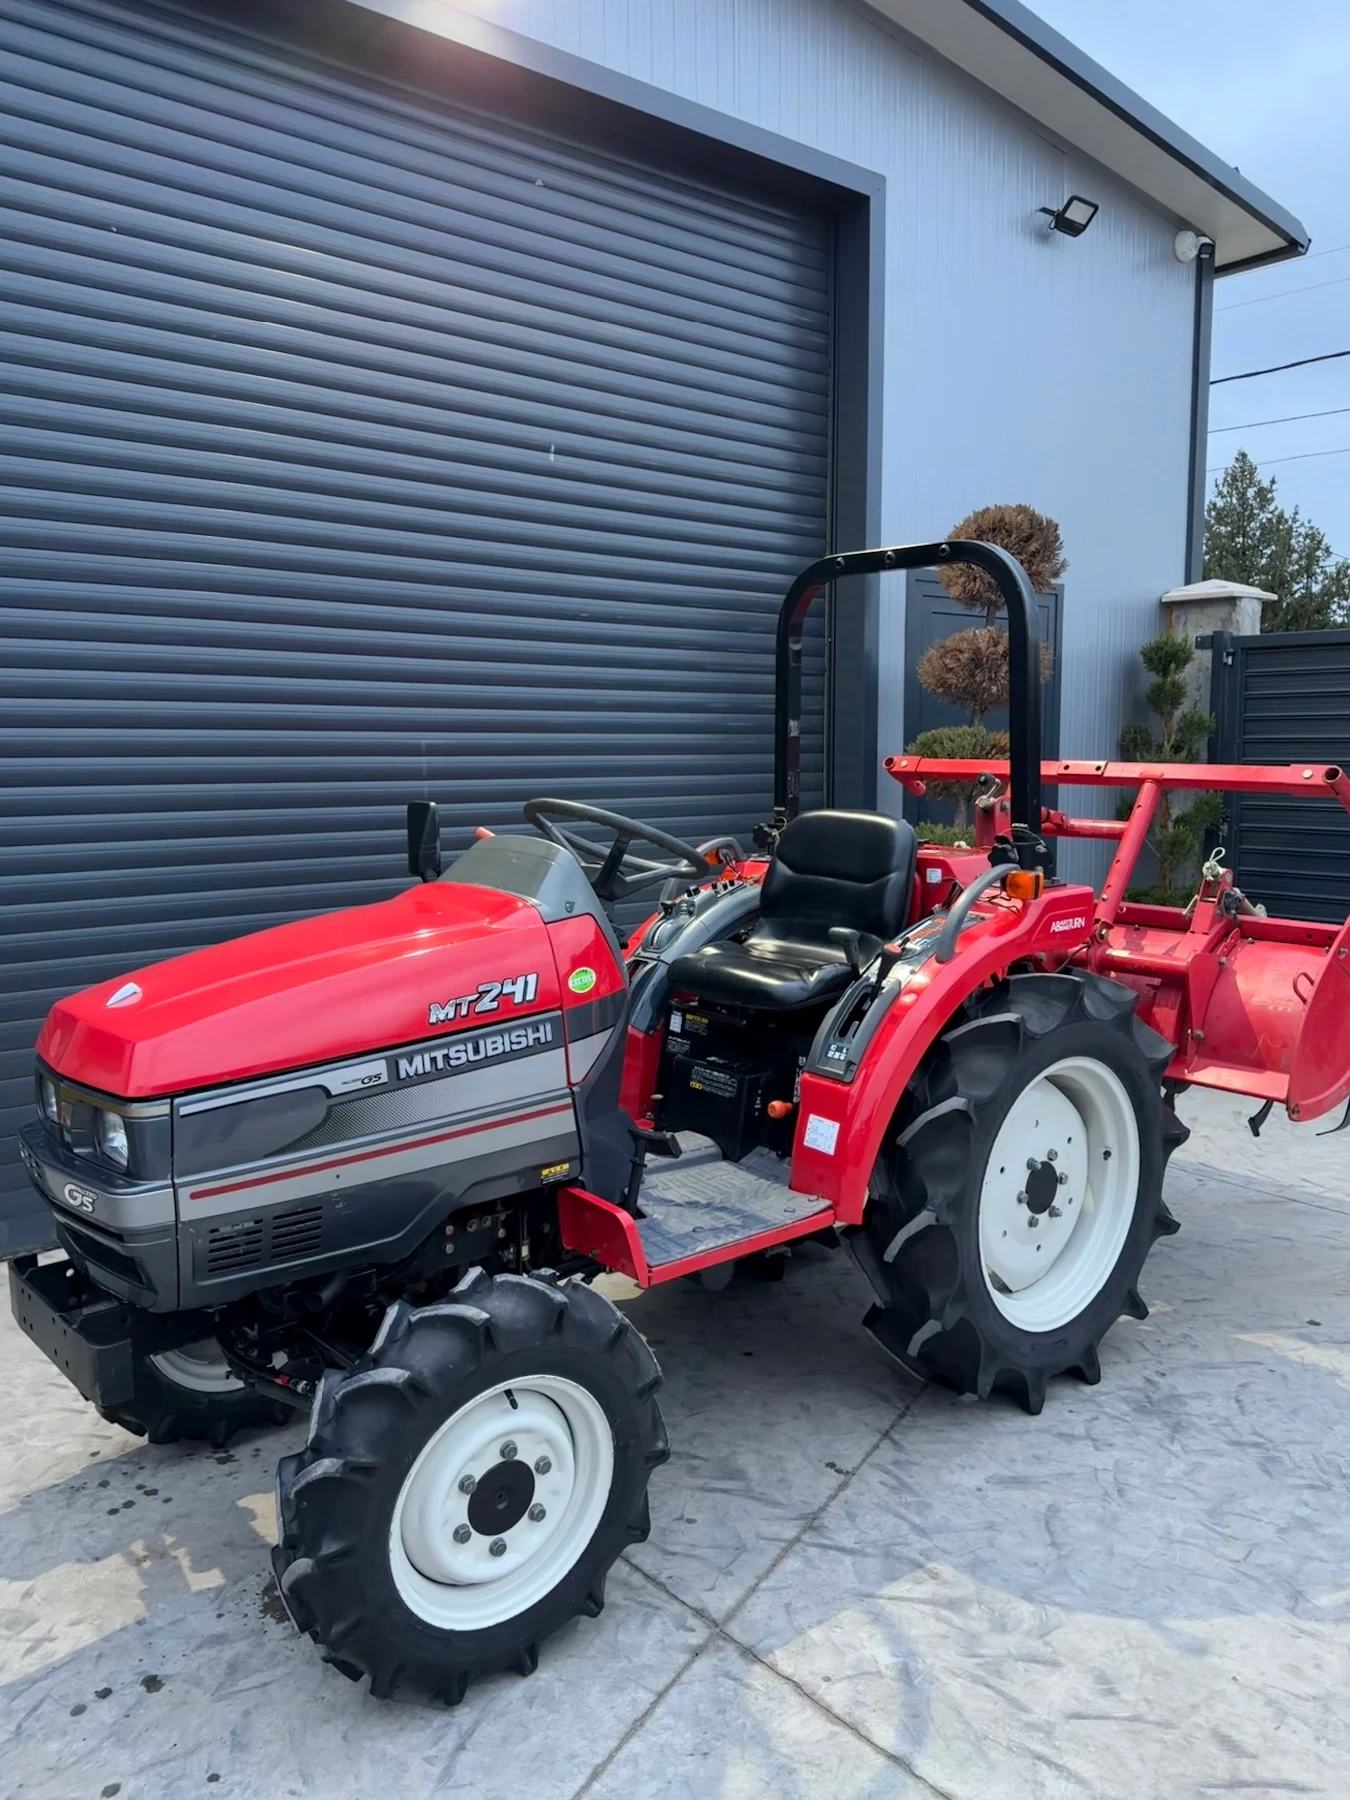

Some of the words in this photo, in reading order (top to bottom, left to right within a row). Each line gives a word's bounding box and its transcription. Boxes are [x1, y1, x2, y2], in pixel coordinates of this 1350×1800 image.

[428, 973, 538, 1024] MT241
[399, 1023, 553, 1081] MITSUBISHI
[361, 1072, 382, 1085] GS
[64, 1183, 94, 1213] GS
